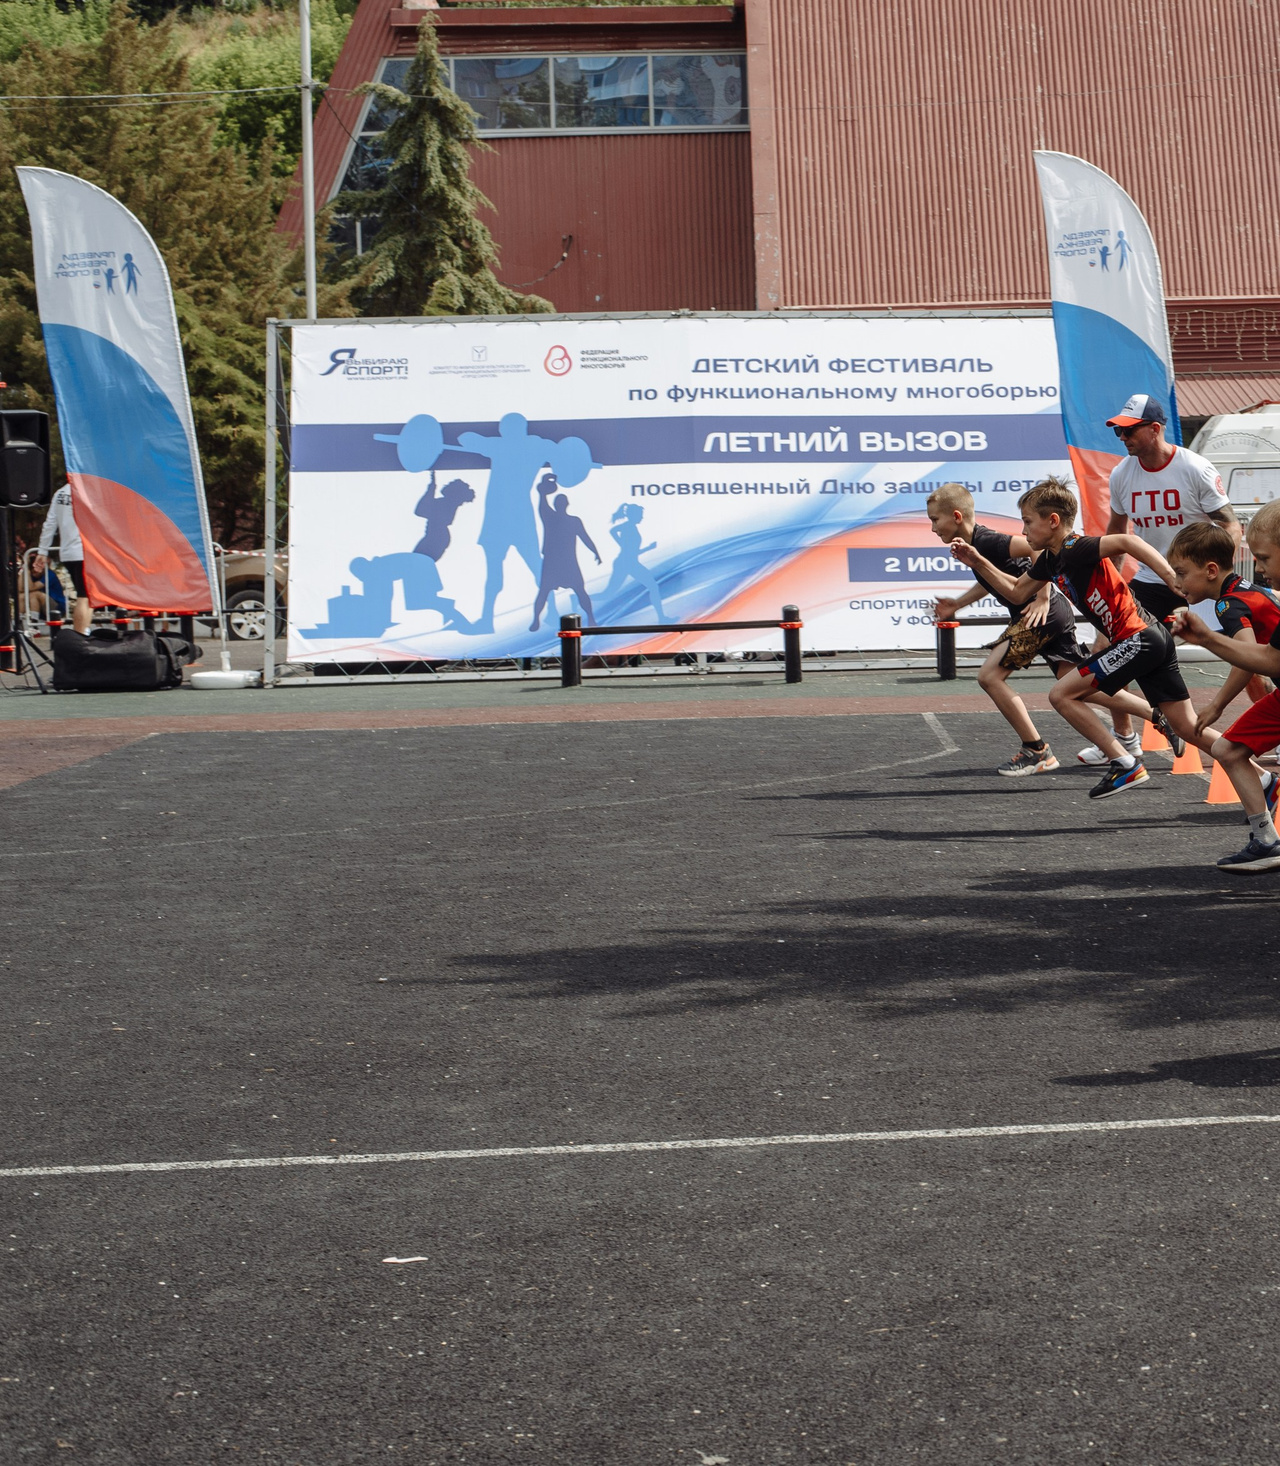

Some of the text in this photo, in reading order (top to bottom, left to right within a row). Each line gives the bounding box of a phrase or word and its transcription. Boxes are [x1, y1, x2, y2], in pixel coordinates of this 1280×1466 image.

[345, 358, 409, 366] ВЫБИРАЮ
[691, 354, 993, 374] ДЕТСКИЙ ФЕСТИВАЛЬ
[628, 383, 1058, 404] по функциональному многоборью
[703, 426, 988, 453] ЛЕТНИЙ ВЫЗОВ
[631, 476, 1059, 497] посвященный Дню защы дет
[1131, 489, 1181, 513] ГТО
[1132, 513, 1184, 528] ИГРЫ
[885, 556, 972, 573] 2 ИЮН
[849, 599, 937, 610] СПОРТИВ
[890, 616, 902, 626] У
